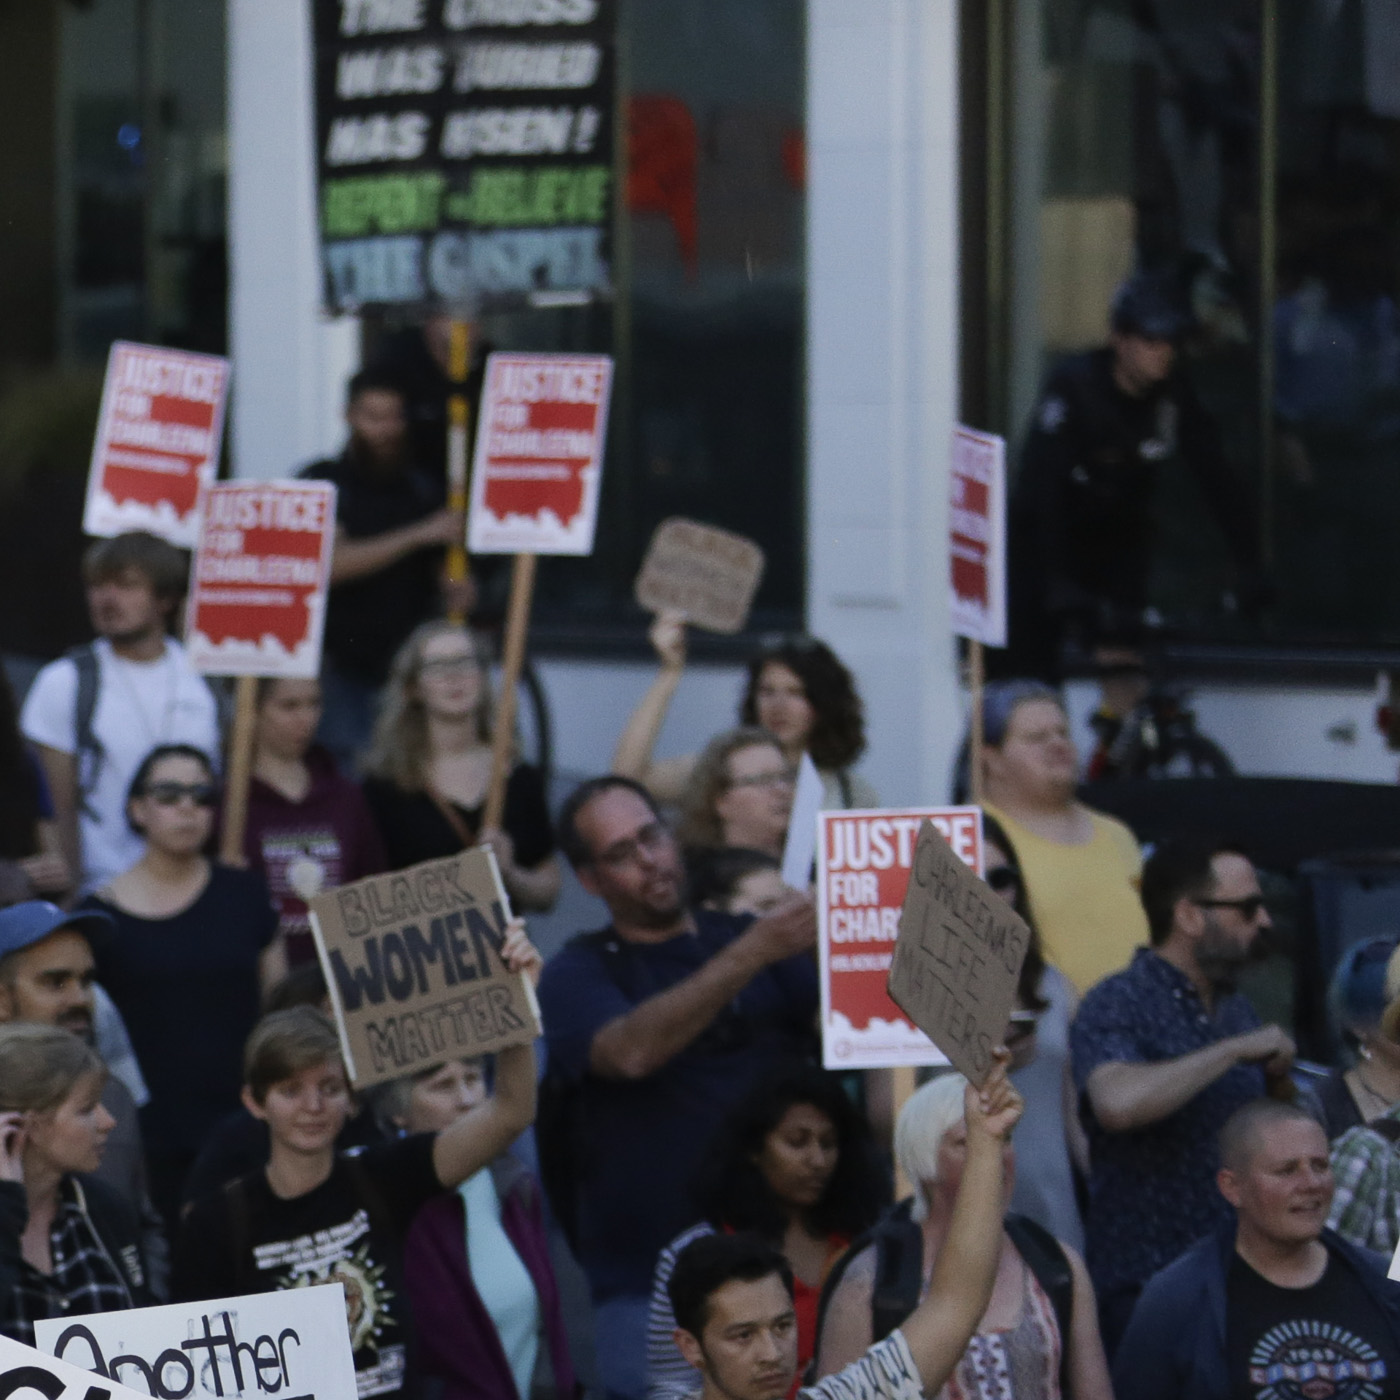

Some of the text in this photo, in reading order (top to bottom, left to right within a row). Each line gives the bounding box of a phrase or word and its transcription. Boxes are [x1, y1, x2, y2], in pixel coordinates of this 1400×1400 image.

[121, 352, 220, 403] JUSTICE
[496, 367, 602, 406] JUSTICE
[206, 494, 326, 537] JUSTICE
[336, 860, 476, 939] BLACK
[830, 870, 879, 906] FOR
[330, 901, 509, 1012] WOMEN
[365, 986, 526, 1074] MATTER
